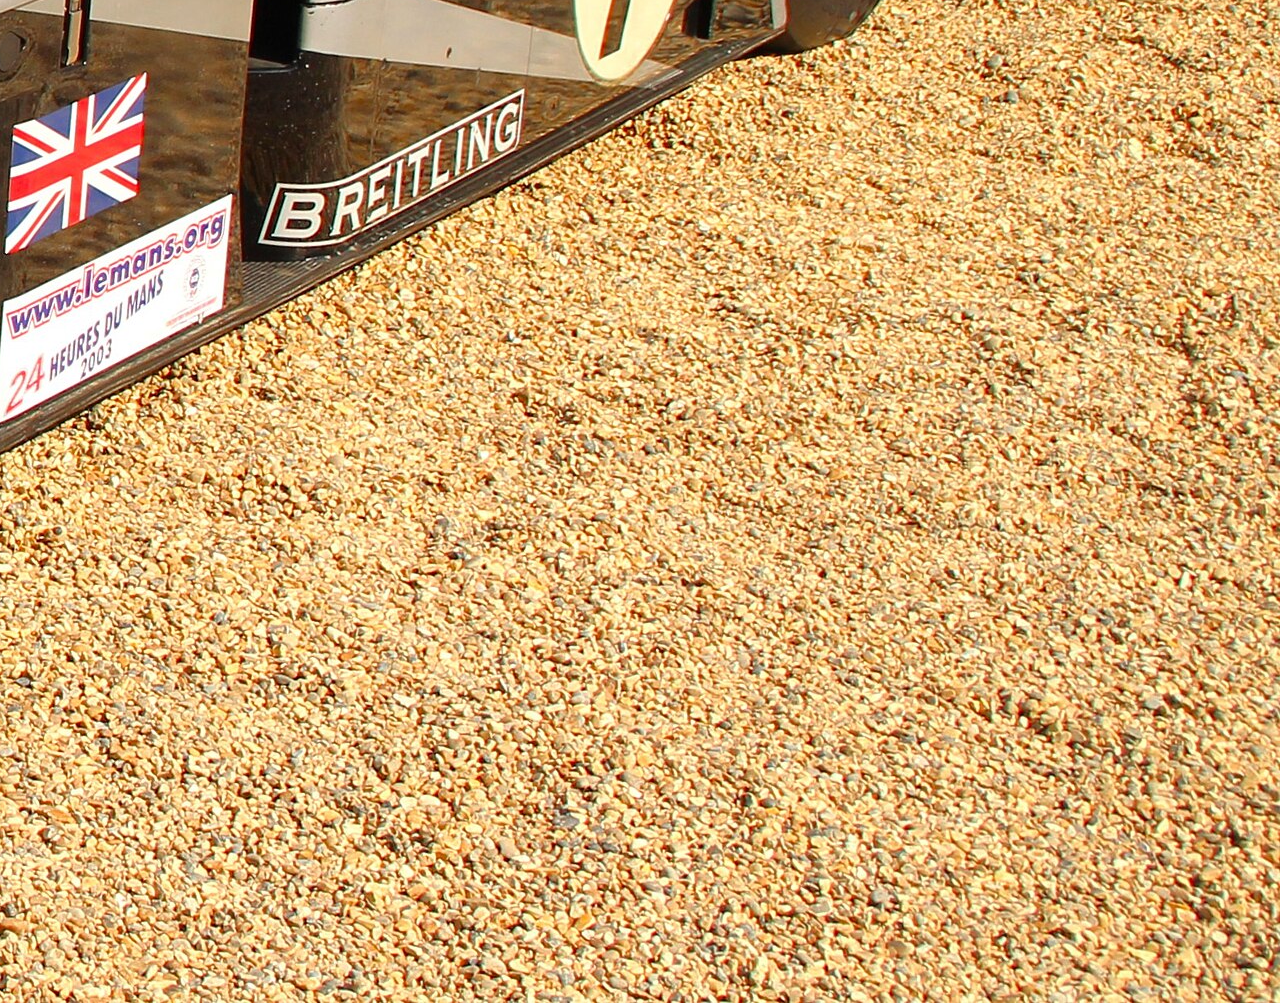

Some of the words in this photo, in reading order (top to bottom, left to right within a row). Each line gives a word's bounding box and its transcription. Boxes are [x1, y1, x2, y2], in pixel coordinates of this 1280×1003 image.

[270, 102, 520, 239] BREITLING
[8, 211, 226, 337] www.lemans.org
[6, 353, 46, 416] 24
[49, 320, 101, 382] HEURES
[104, 303, 123, 338] DU
[126, 270, 165, 321] MANS
[79, 339, 113, 380] 2003
